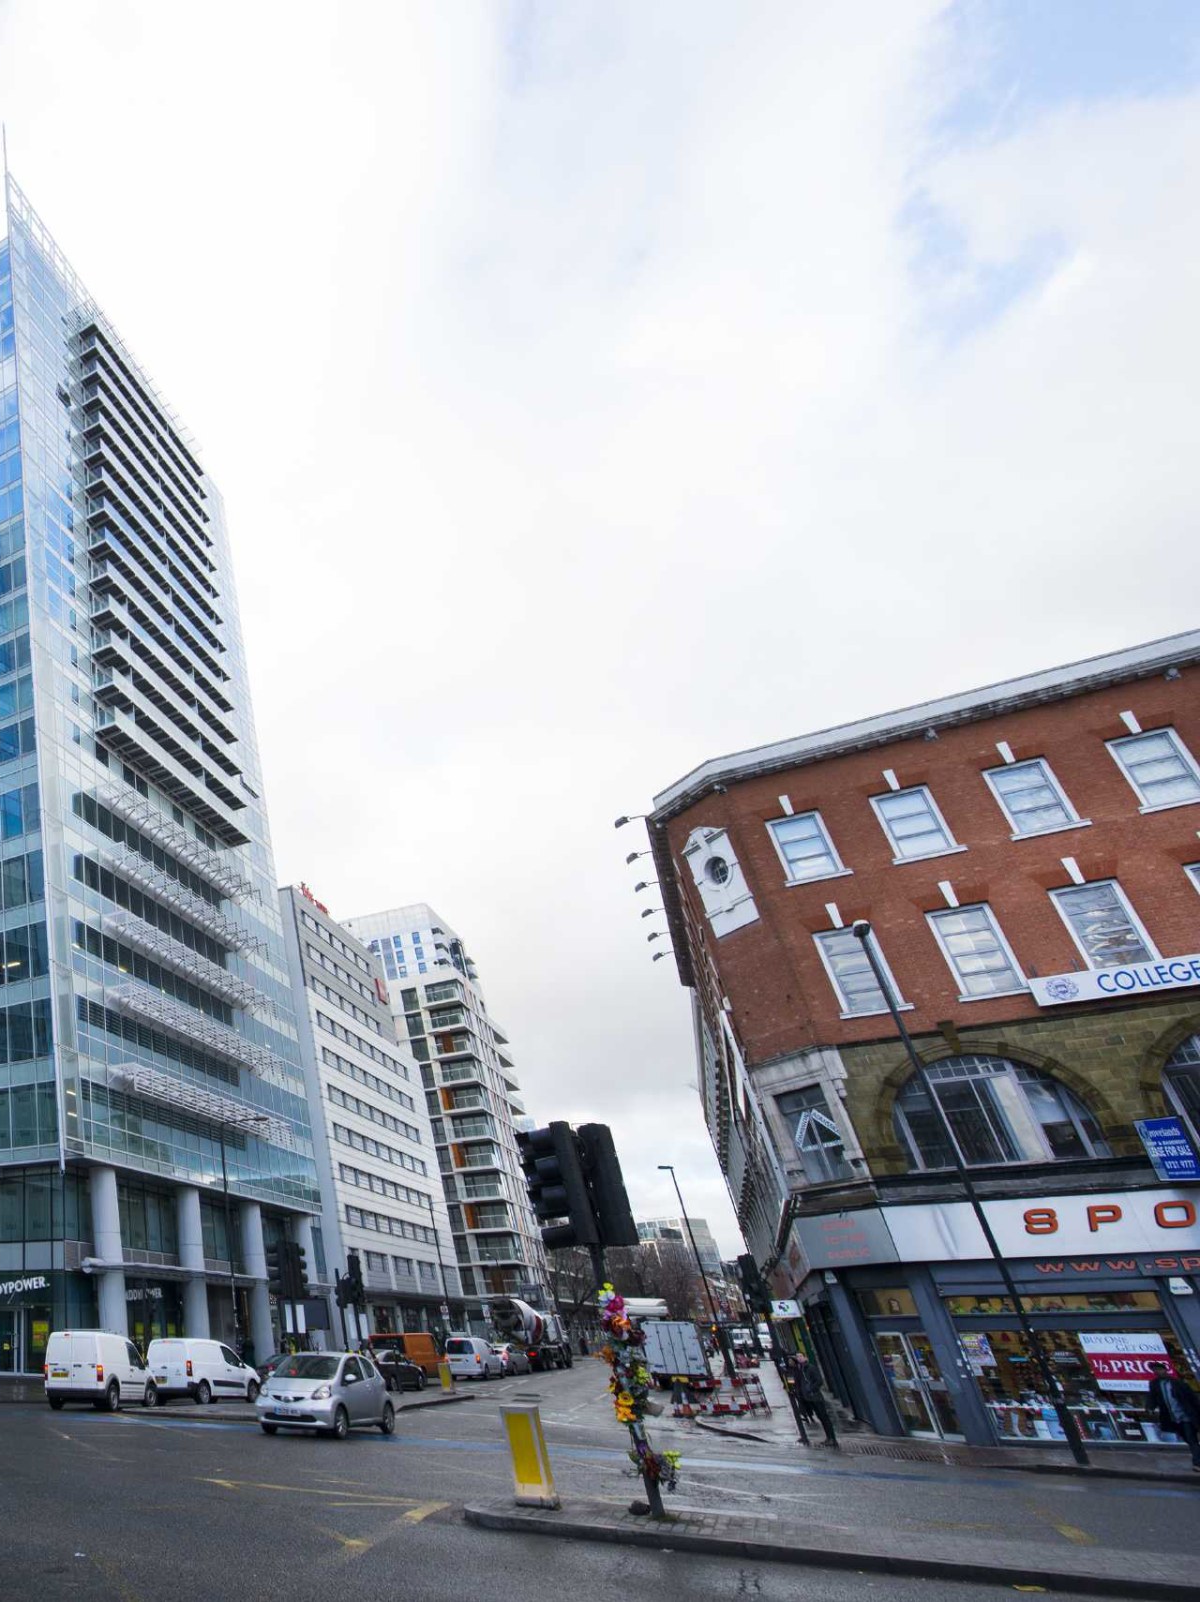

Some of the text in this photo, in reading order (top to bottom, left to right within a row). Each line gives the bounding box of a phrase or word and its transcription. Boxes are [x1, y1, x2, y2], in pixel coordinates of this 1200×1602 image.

[1097, 960, 1200, 993] COLLEGE
[1082, 1336, 1130, 1344] BUY ONE
[1115, 1343, 1164, 1352] GET ONE
